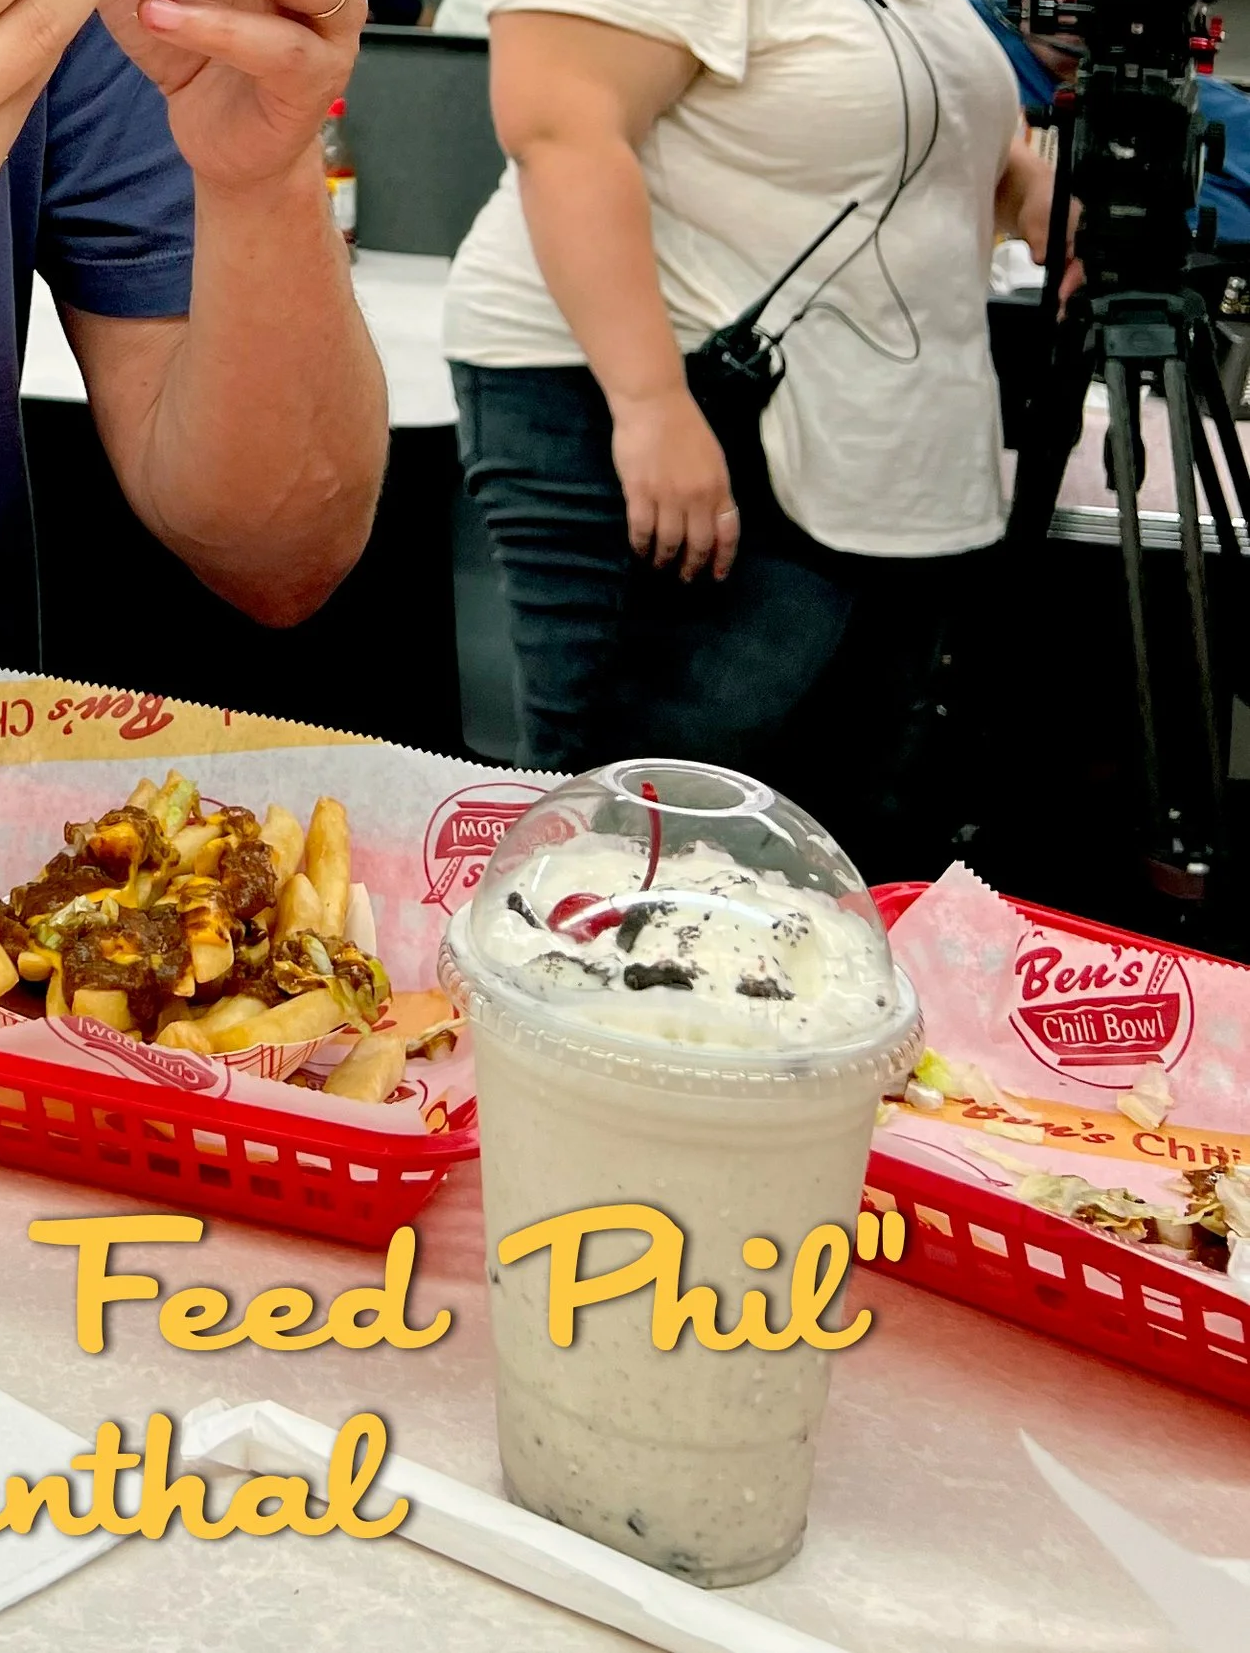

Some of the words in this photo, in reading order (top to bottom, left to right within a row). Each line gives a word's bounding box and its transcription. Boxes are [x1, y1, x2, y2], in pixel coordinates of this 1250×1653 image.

[48, 693, 174, 740] Ben's
[1014, 945, 1143, 1001] Ben's
[1042, 1014, 1097, 1043] Chili
[1103, 1010, 1166, 1041] Bowl
